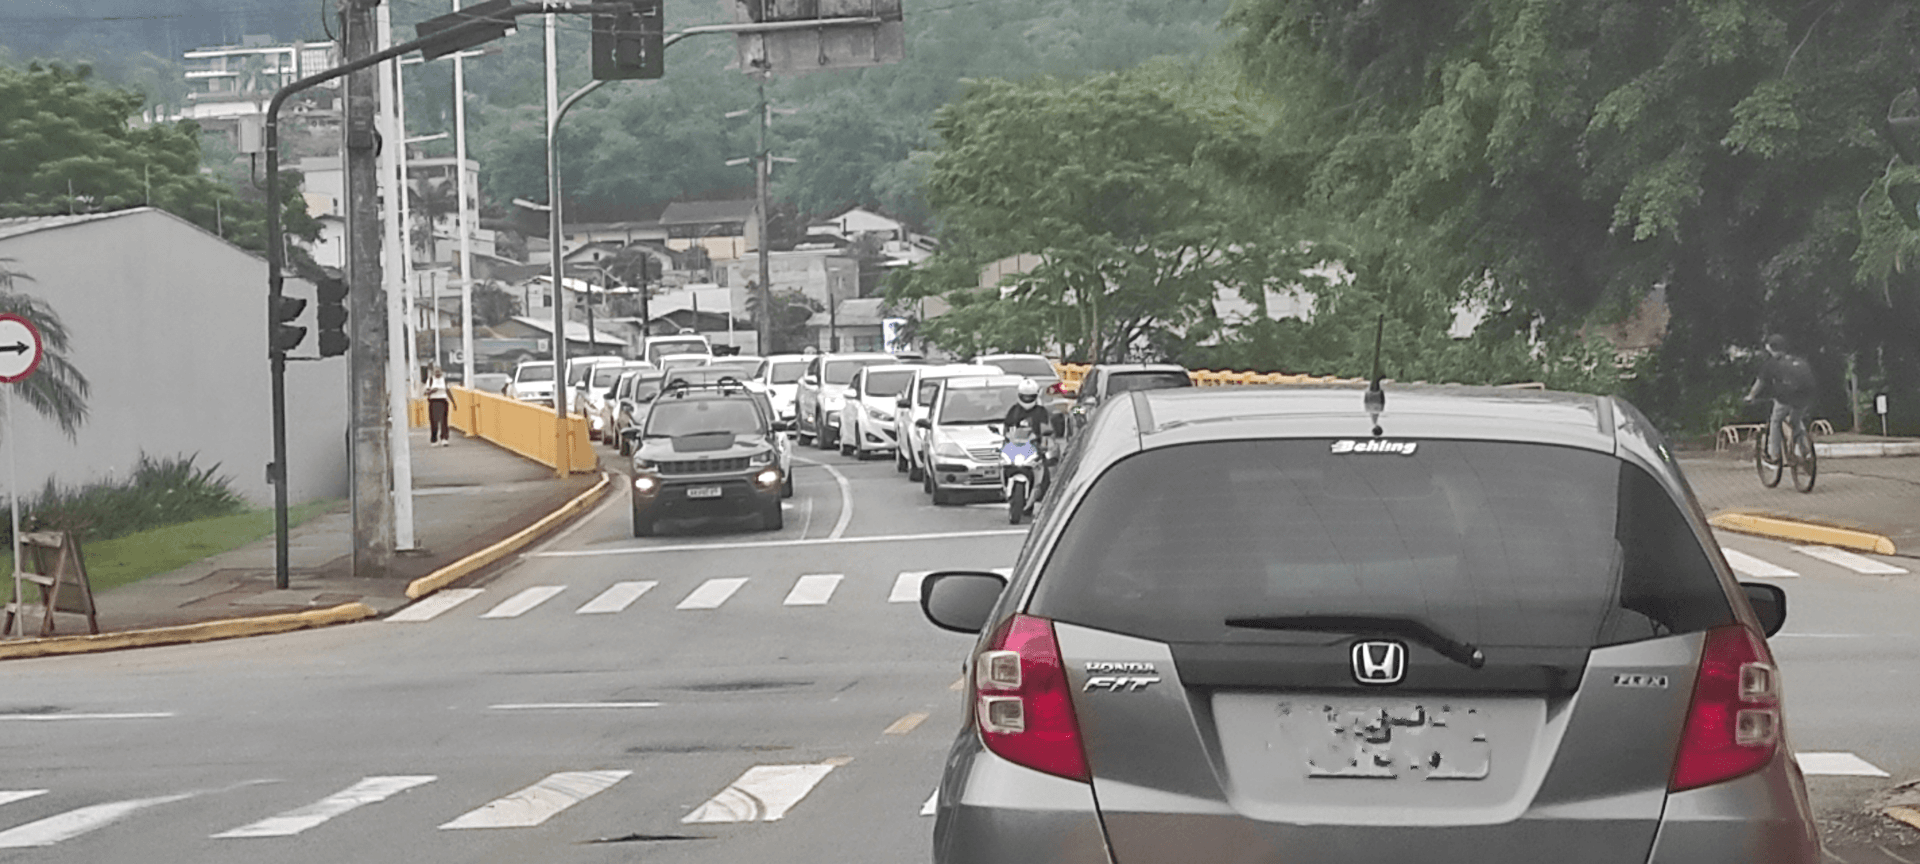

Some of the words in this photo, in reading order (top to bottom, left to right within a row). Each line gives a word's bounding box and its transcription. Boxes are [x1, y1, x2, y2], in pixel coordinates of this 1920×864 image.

[1331, 440, 1417, 455] Behling
[1085, 661, 1159, 674] HONDA
[1082, 676, 1162, 692] FIT
